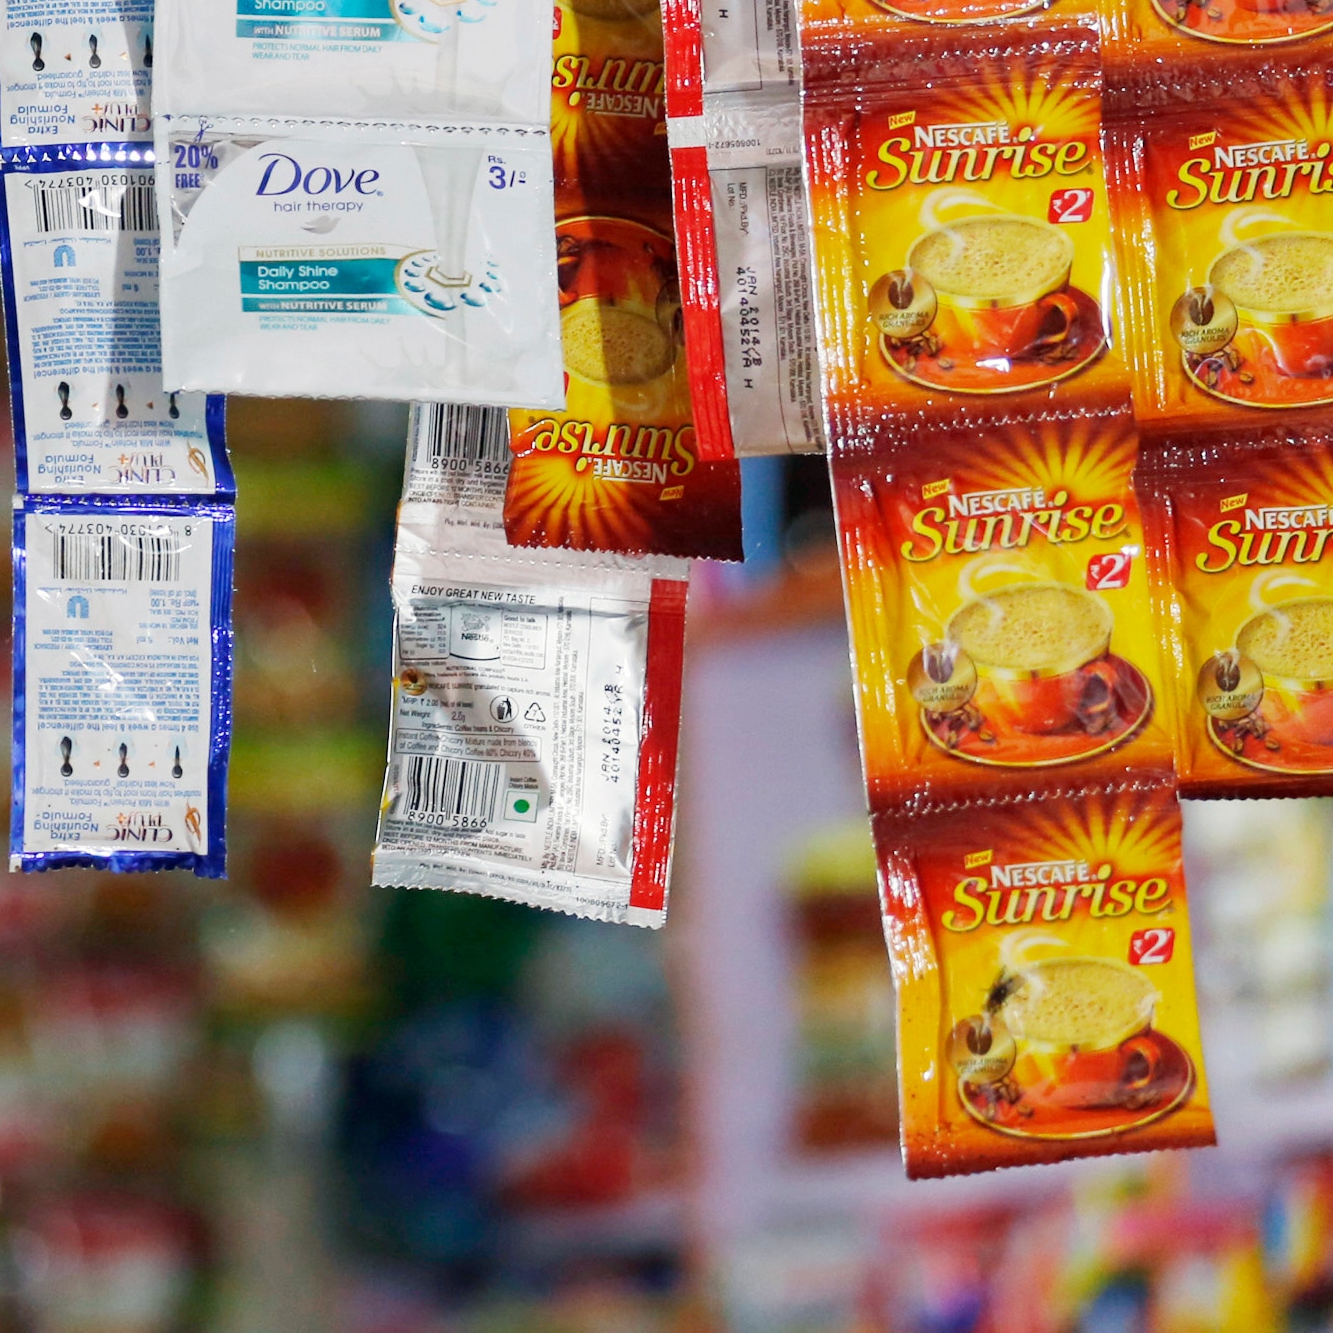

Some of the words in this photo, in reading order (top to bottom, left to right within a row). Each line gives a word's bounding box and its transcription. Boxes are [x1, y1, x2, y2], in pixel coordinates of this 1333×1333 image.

[256, 154, 379, 196] Dove
[866, 130, 1091, 190] Sunrise
[536, 418, 694, 475] Sunrise
[902, 493, 1123, 562] Sunrise
[411, 585, 442, 596] ENJOY
[445, 587, 473, 600] GREAT
[477, 590, 502, 602] NEW
[506, 591, 536, 605] TASTE
[408, 811, 443, 825] 8900
[452, 816, 488, 829] 5866
[942, 864, 1170, 932] Sunrise
